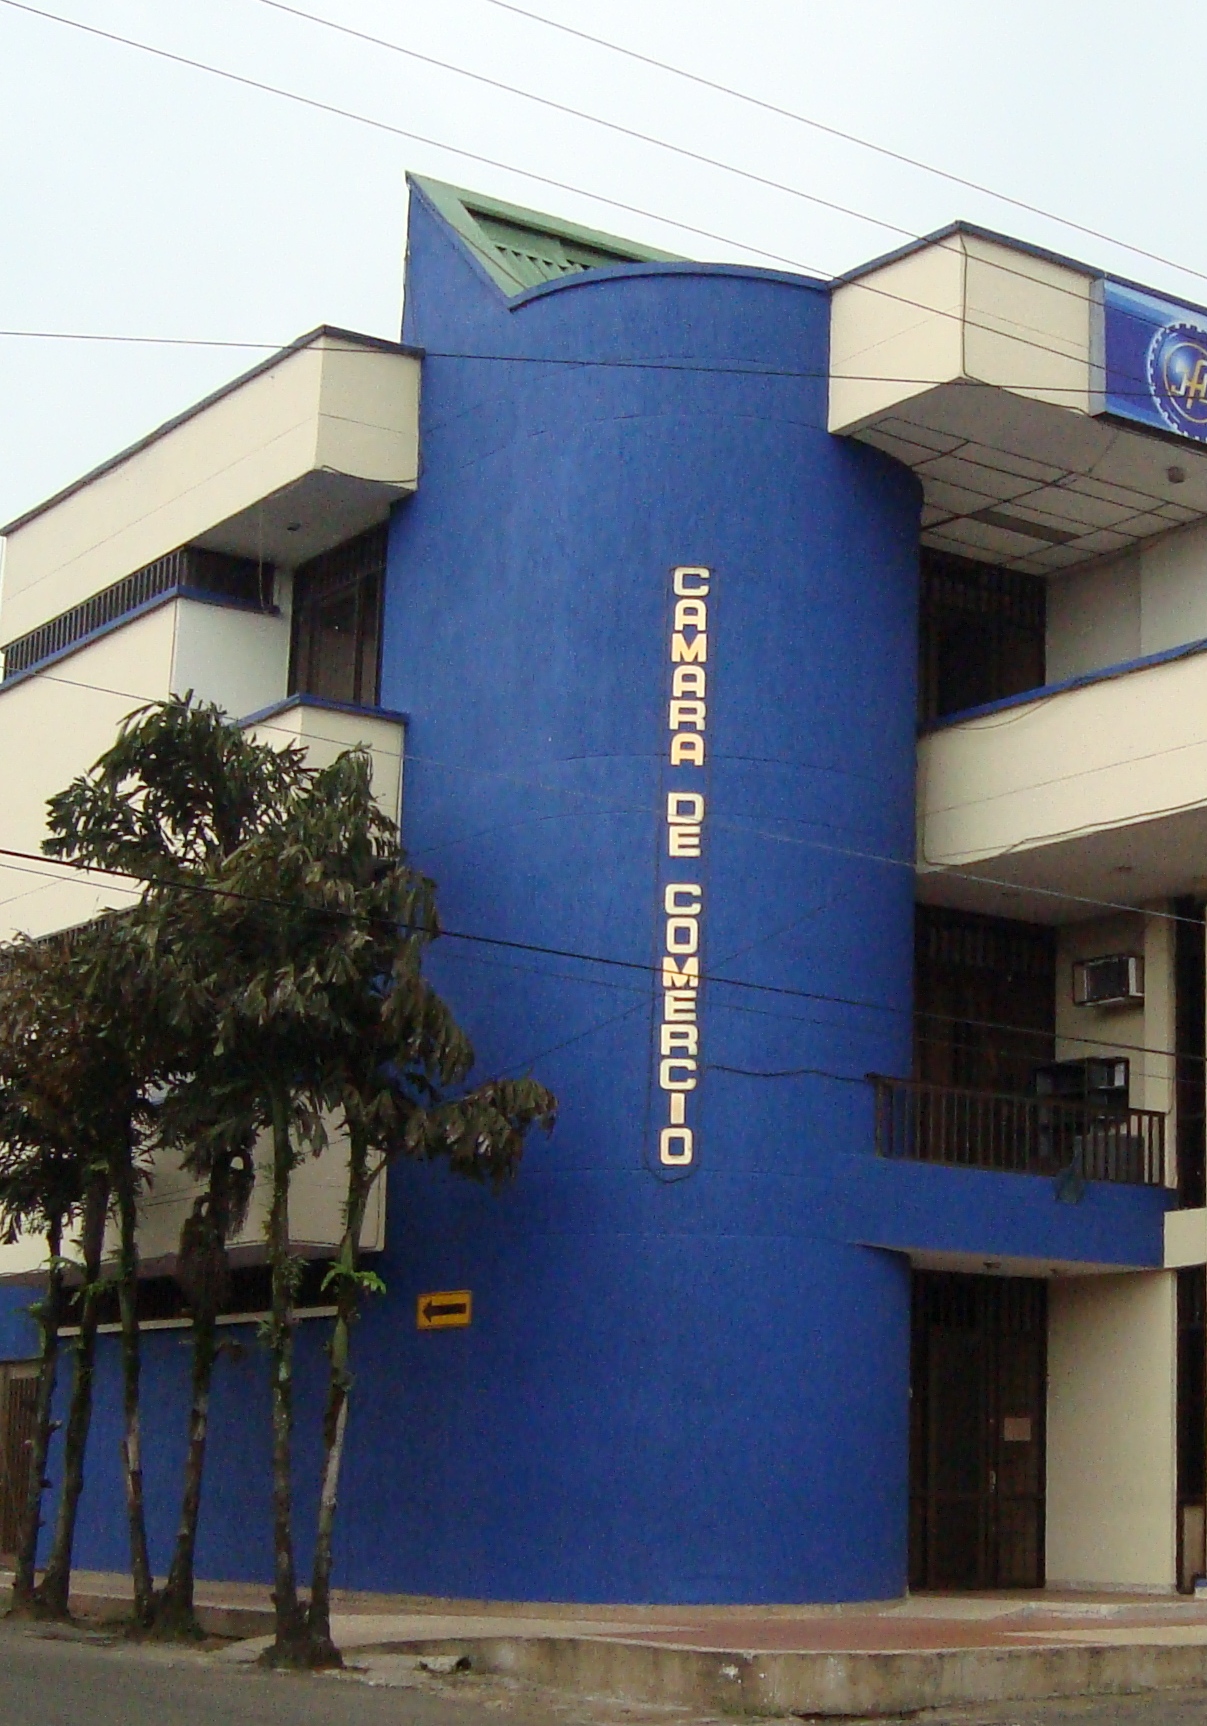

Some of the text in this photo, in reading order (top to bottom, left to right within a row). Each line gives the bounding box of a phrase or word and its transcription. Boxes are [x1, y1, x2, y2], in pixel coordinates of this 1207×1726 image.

[659, 566, 710, 1166] CAMARA DE COMERCIO
